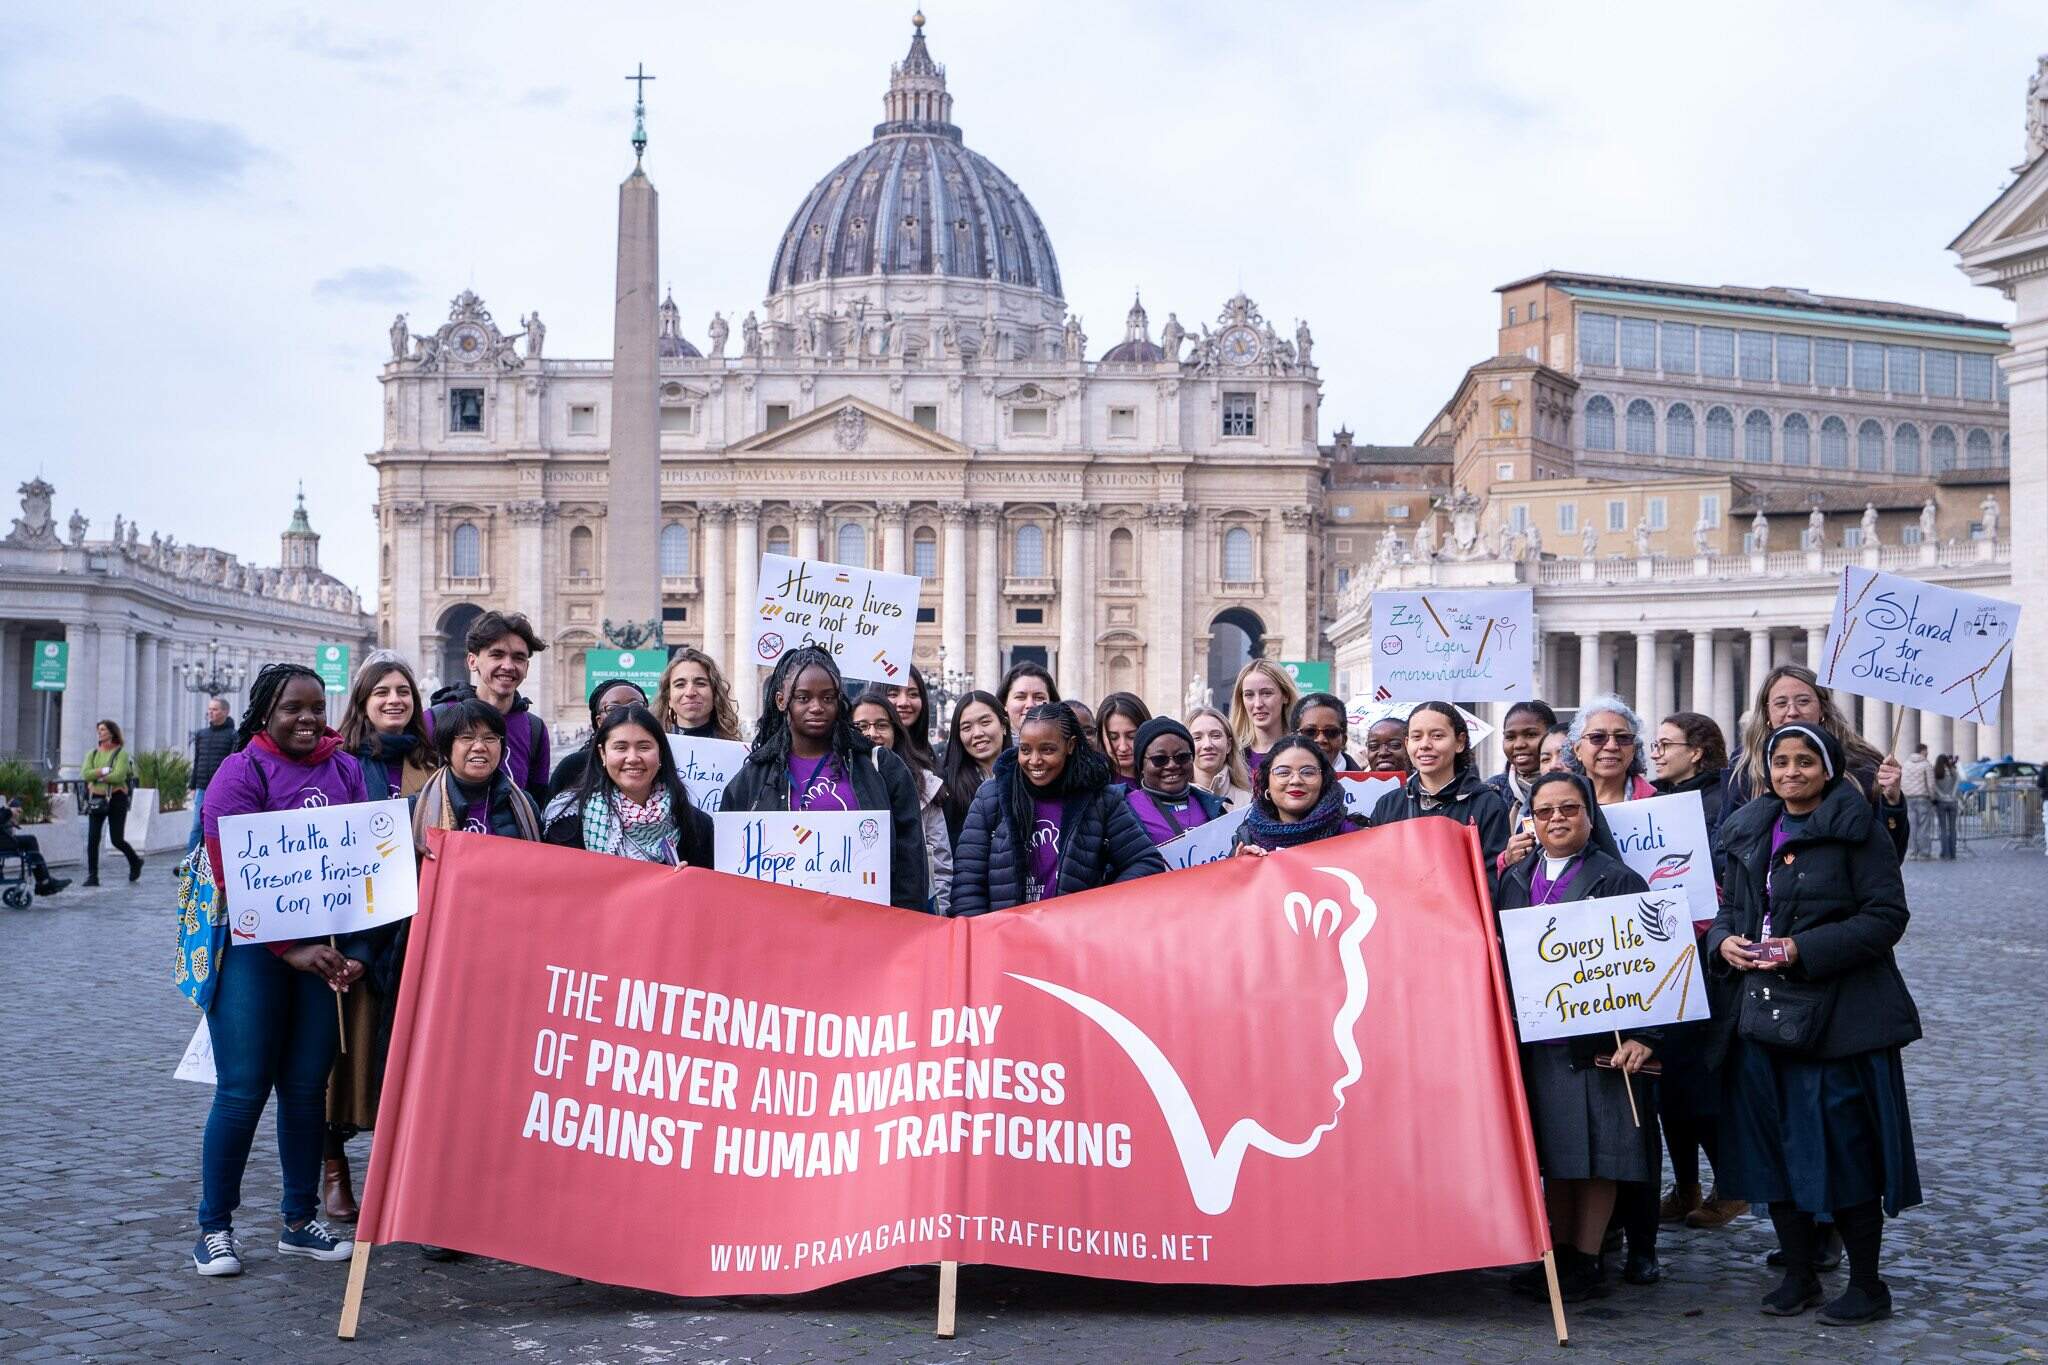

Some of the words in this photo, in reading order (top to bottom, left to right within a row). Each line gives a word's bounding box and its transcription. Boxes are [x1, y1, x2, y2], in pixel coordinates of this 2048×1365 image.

[777, 561, 853, 614] Human
[862, 579, 903, 617] lives
[784, 611, 812, 627] are
[818, 612, 848, 633] not
[855, 614, 880, 636] for
[1390, 605, 1424, 638] Zeg
[1865, 592, 1958, 643] Stand
[1383, 641, 1401, 649] STOP
[1426, 632, 1471, 662] tegen
[1851, 636, 1934, 688] Justice
[1896, 638, 1922, 662] for
[675, 750, 724, 782] stizia
[697, 788, 721, 812] Vit
[238, 830, 269, 859] La
[277, 823, 329, 854] tratta
[340, 820, 357, 847] di
[737, 818, 796, 883] Hope
[804, 831, 825, 872] at
[830, 835, 851, 873] all
[1613, 812, 1666, 853] vidi
[239, 862, 313, 891] Persone
[321, 854, 381, 882] finisce
[323, 884, 352, 912] noi
[1538, 916, 1604, 962] Every
[1610, 915, 1644, 950] life
[1573, 956, 1656, 984] deserves
[545, 964, 609, 1024] THE
[614, 977, 917, 1058] INTERNATIONAL
[930, 1004, 1003, 1048] DAY
[1545, 982, 1652, 1024] Freedom
[533, 1028, 579, 1080] OF
[585, 1038, 739, 1110] PRAYER
[751, 1066, 818, 1117] AND
[828, 1056, 1067, 1118] AWARENESS
[522, 1090, 704, 1170] AGAINST
[712, 1124, 860, 1179] HUMAN
[874, 1110, 1132, 1169] TRAFFICKING
[710, 1212, 1214, 1272] WWW.PRAYAGAINSTTRAFFICKING.NET
